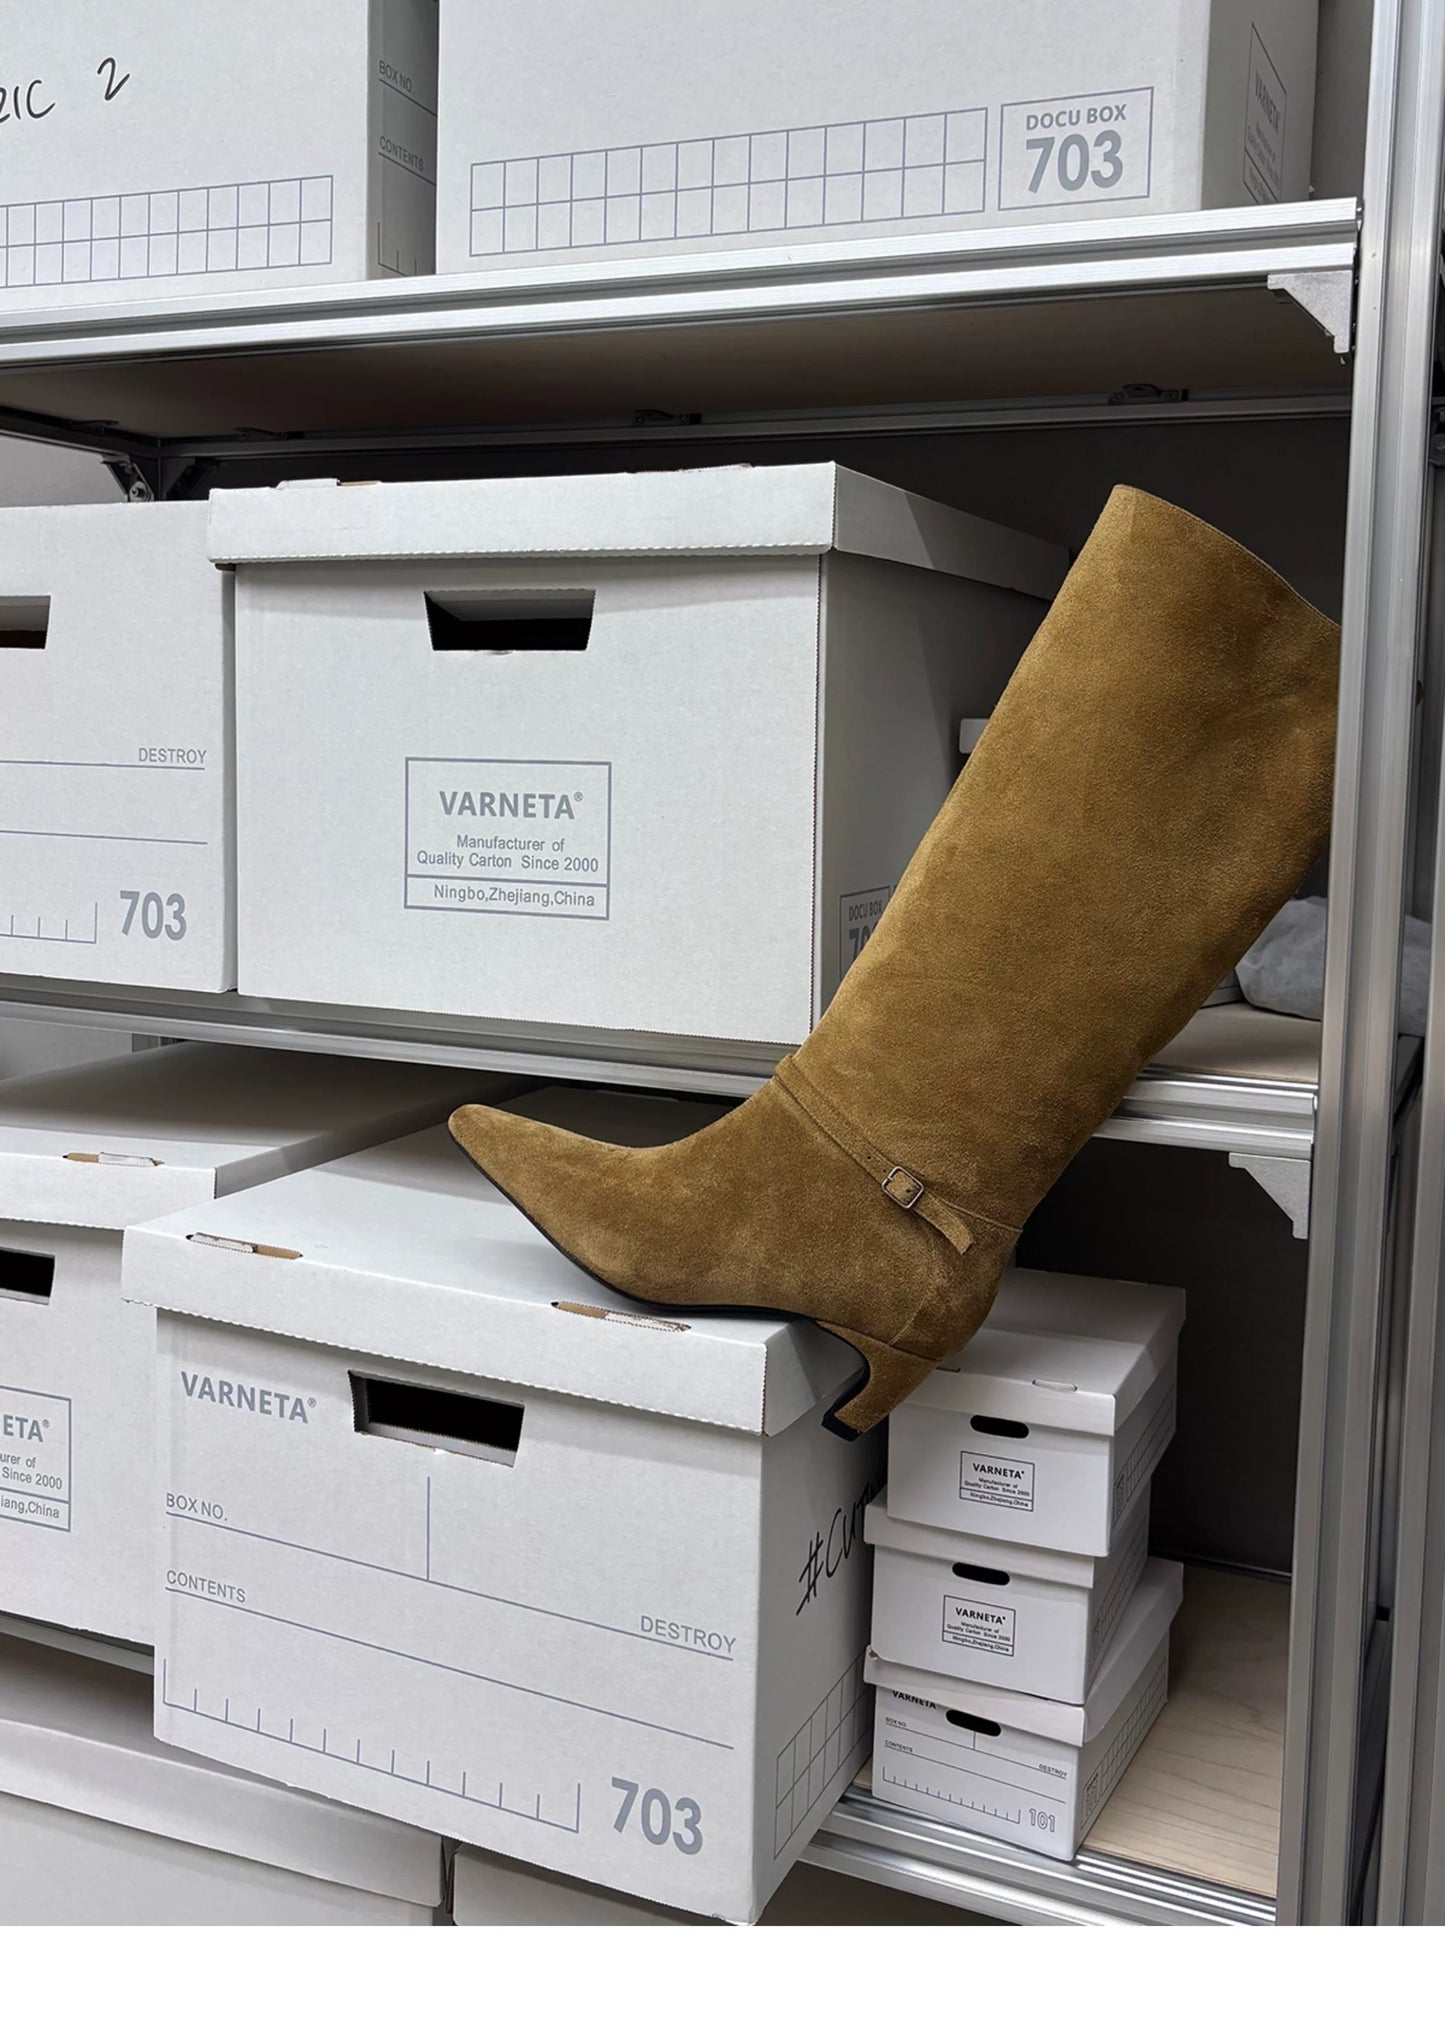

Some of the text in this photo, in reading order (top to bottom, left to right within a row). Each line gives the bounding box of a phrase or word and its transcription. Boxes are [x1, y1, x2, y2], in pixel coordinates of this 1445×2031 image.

[97, 57, 130, 101] 2
[379, 60, 399, 84] BOX
[1026, 103, 1128, 131] DOCU BOX
[379, 136, 425, 172] CONTENTS
[1025, 129, 1123, 194] 703
[138, 748, 207, 764] DESTROY
[456, 834, 565, 852] Manufacturer of
[417, 850, 599, 872] Quality Carton Since 2000
[119, 890, 188, 941] 703
[848, 904, 869, 921] DOCU
[25, 1456, 36, 1469] of
[2, 1466, 63, 1490] Since 2000
[166, 1492, 228, 1521] BOX NO.
[166, 1570, 247, 1603] CONTENTS
[640, 1615, 737, 1653] DESTROY
[611, 1776, 703, 1855] 703
[1029, 1807, 1056, 1833] 101
